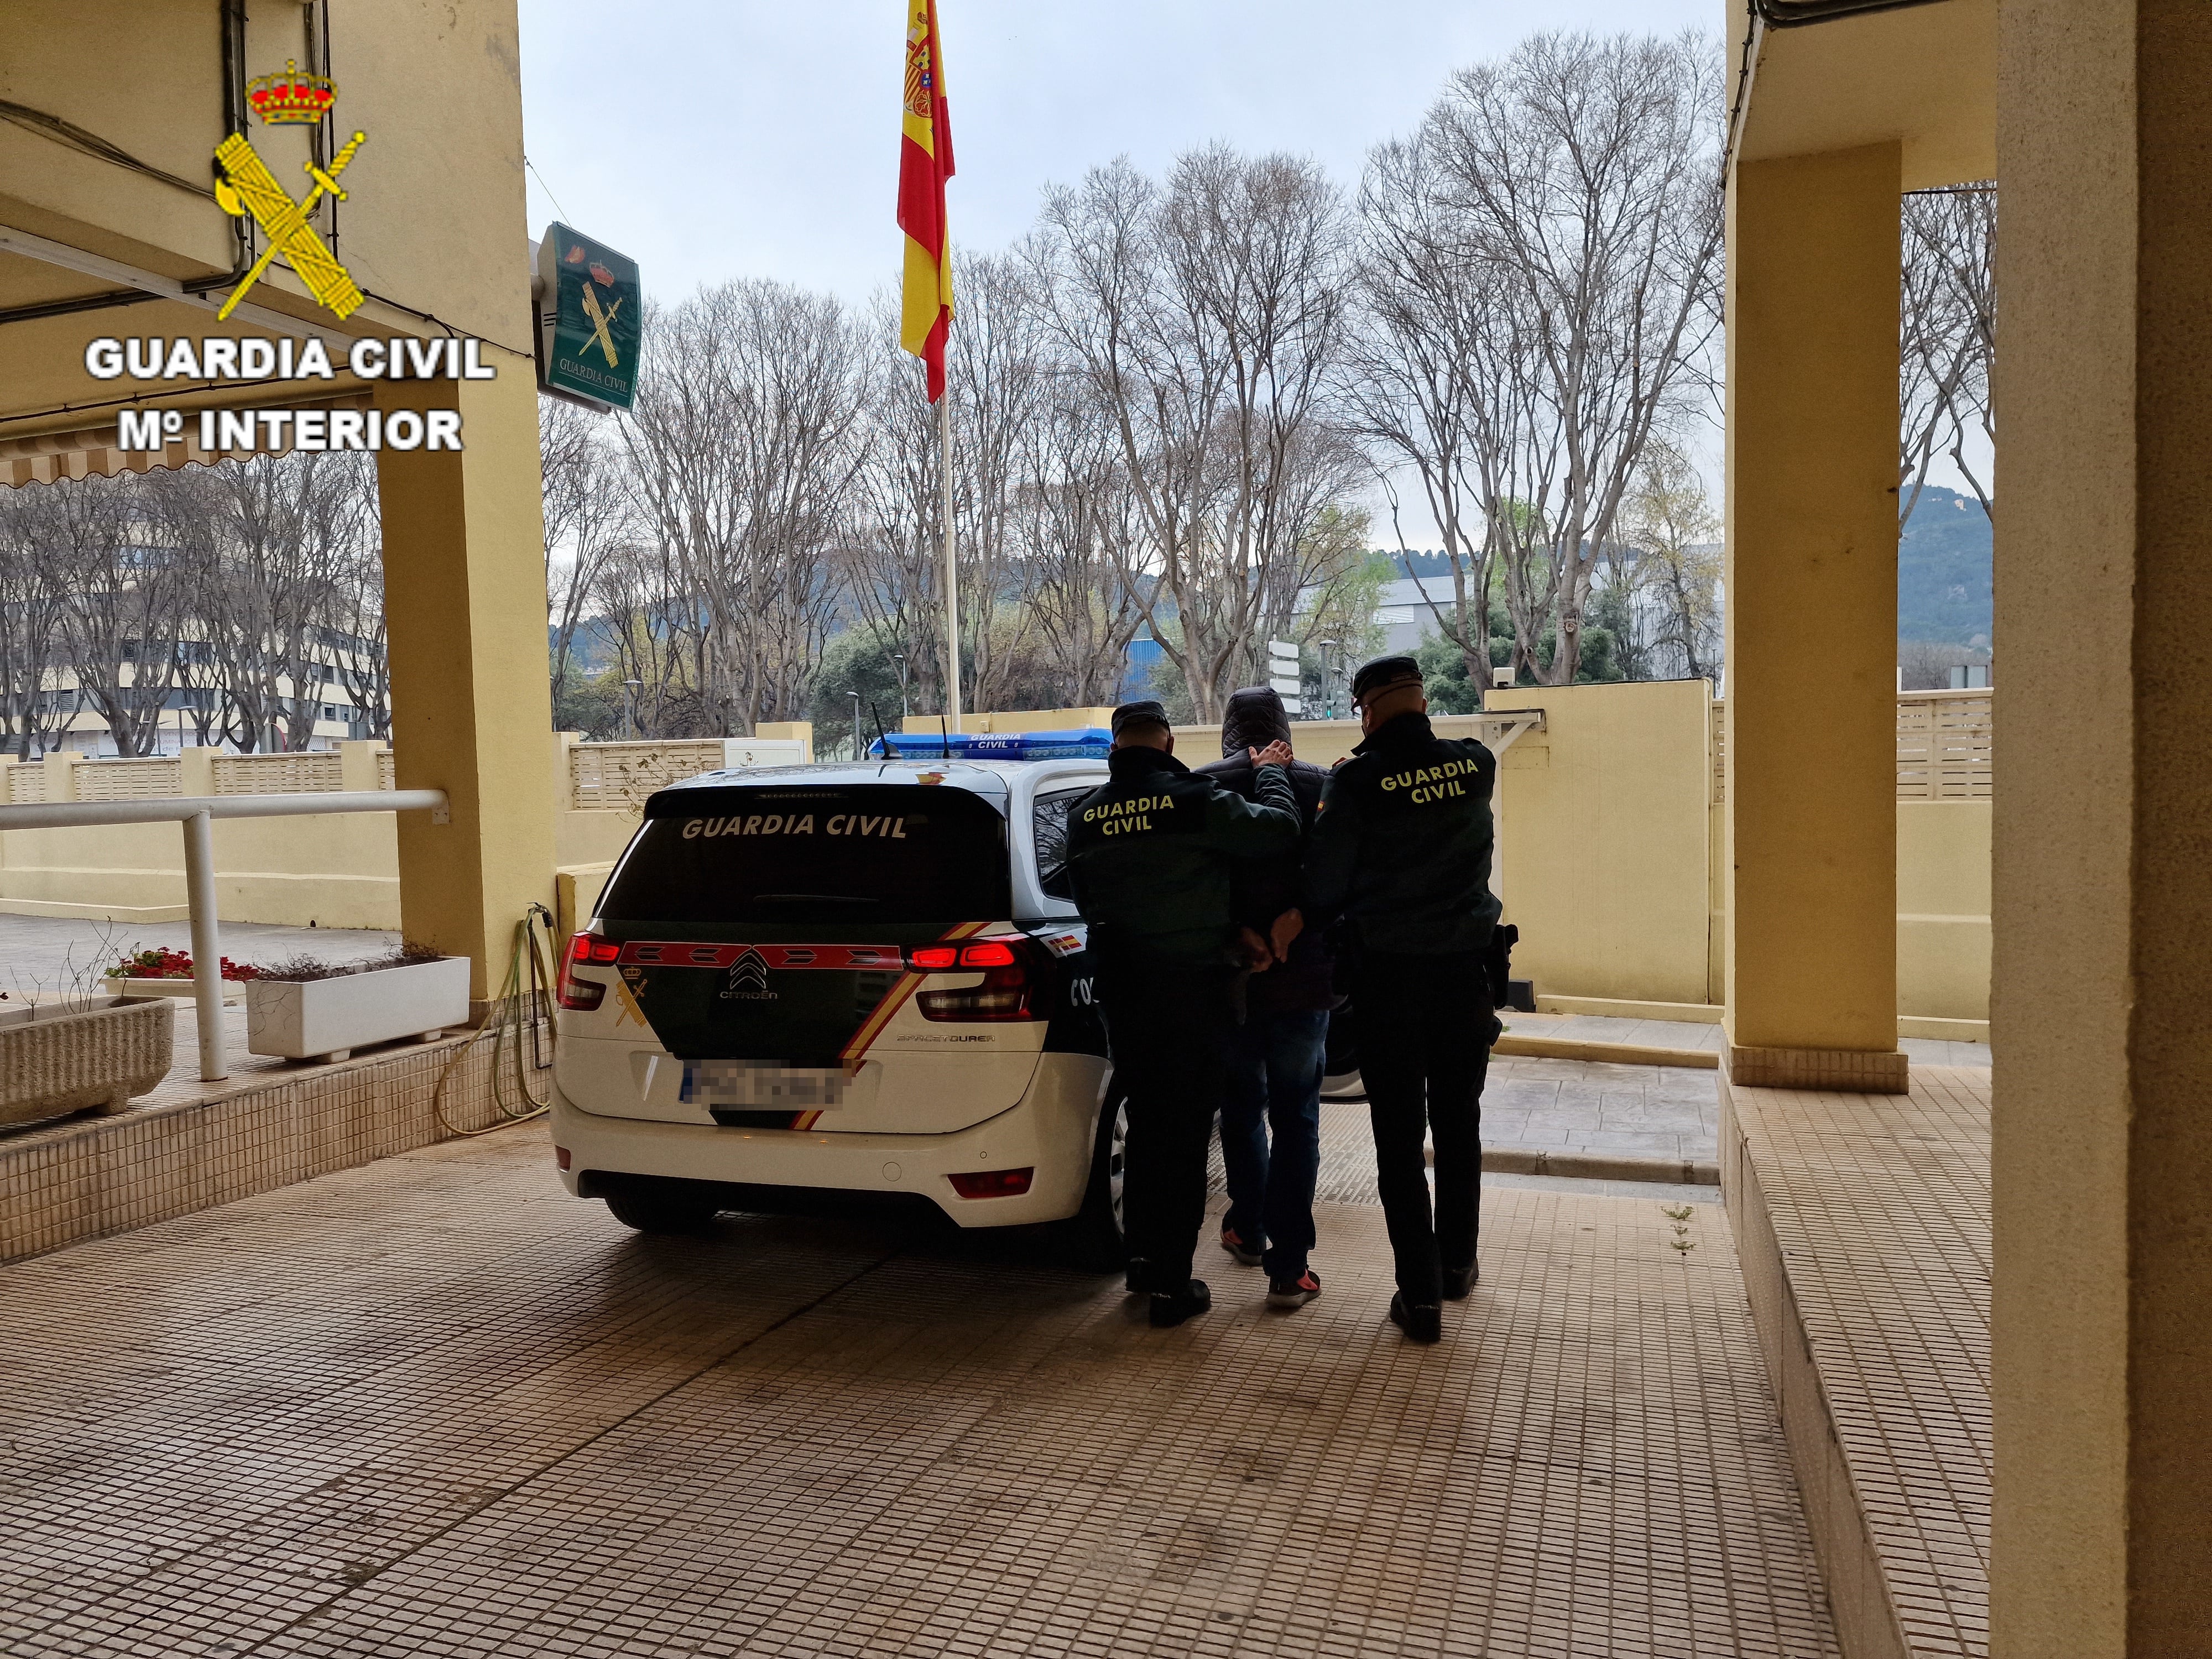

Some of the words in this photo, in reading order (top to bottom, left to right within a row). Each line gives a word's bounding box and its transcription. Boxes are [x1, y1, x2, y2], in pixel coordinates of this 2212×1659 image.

[560, 358, 602, 384] GUARDIA
[604, 375, 628, 393] CIVIL
[978, 740, 1008, 749] CIVIL
[1381, 759, 1479, 791] GUARDIA
[1411, 780, 1466, 804] CIVIL
[1083, 795, 1175, 822] GUARDIA
[682, 814, 813, 839] GUARDIA
[826, 815, 906, 838] CIVIL
[1102, 815, 1152, 835] CIVIL
[896, 1034, 995, 1042] SPACETOURER
